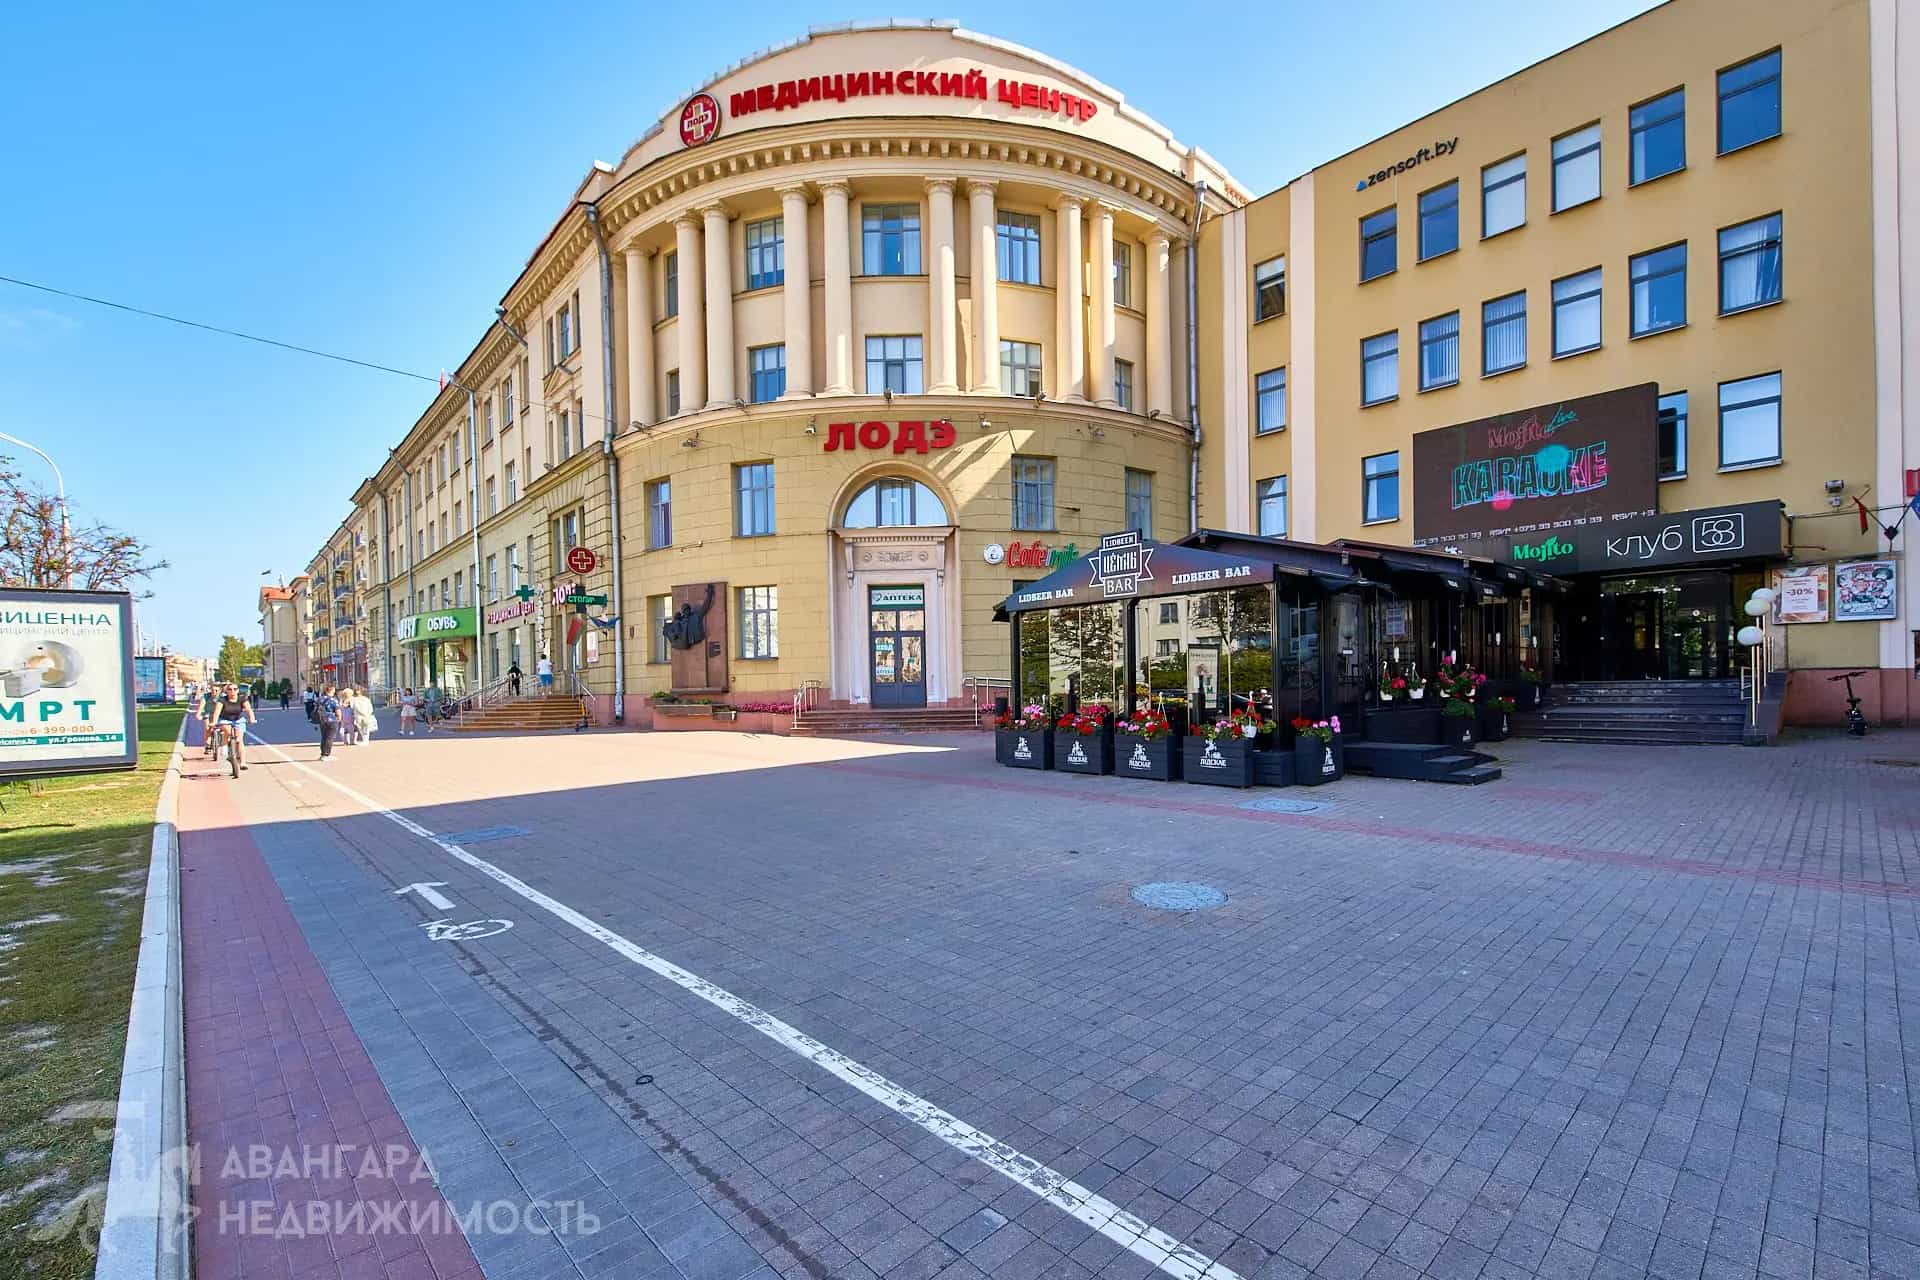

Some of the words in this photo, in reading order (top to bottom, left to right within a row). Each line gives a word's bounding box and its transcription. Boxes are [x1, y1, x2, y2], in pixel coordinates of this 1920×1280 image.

[730, 69, 987, 118] МЕДИЦИНСКИЙ
[998, 78, 1098, 122] ЦЕНТР
[1367, 136, 1458, 187] zensoft.by
[824, 421, 957, 454] ЛОДЭ
[1452, 440, 1609, 510] KARAOKE
[1513, 535, 1574, 562] Mojito
[1606, 524, 1683, 559] клуб
[1701, 518, 1736, 547] 58
[1106, 577, 1133, 594] BAR
[1172, 570, 1220, 585] LIDBEER
[1225, 565, 1251, 578] BAR
[1018, 591, 1053, 603] LIDBEER
[1055, 588, 1074, 599] BAR
[427, 615, 458, 632] ОБУВЬ
[0, 700, 97, 722] МРТ
